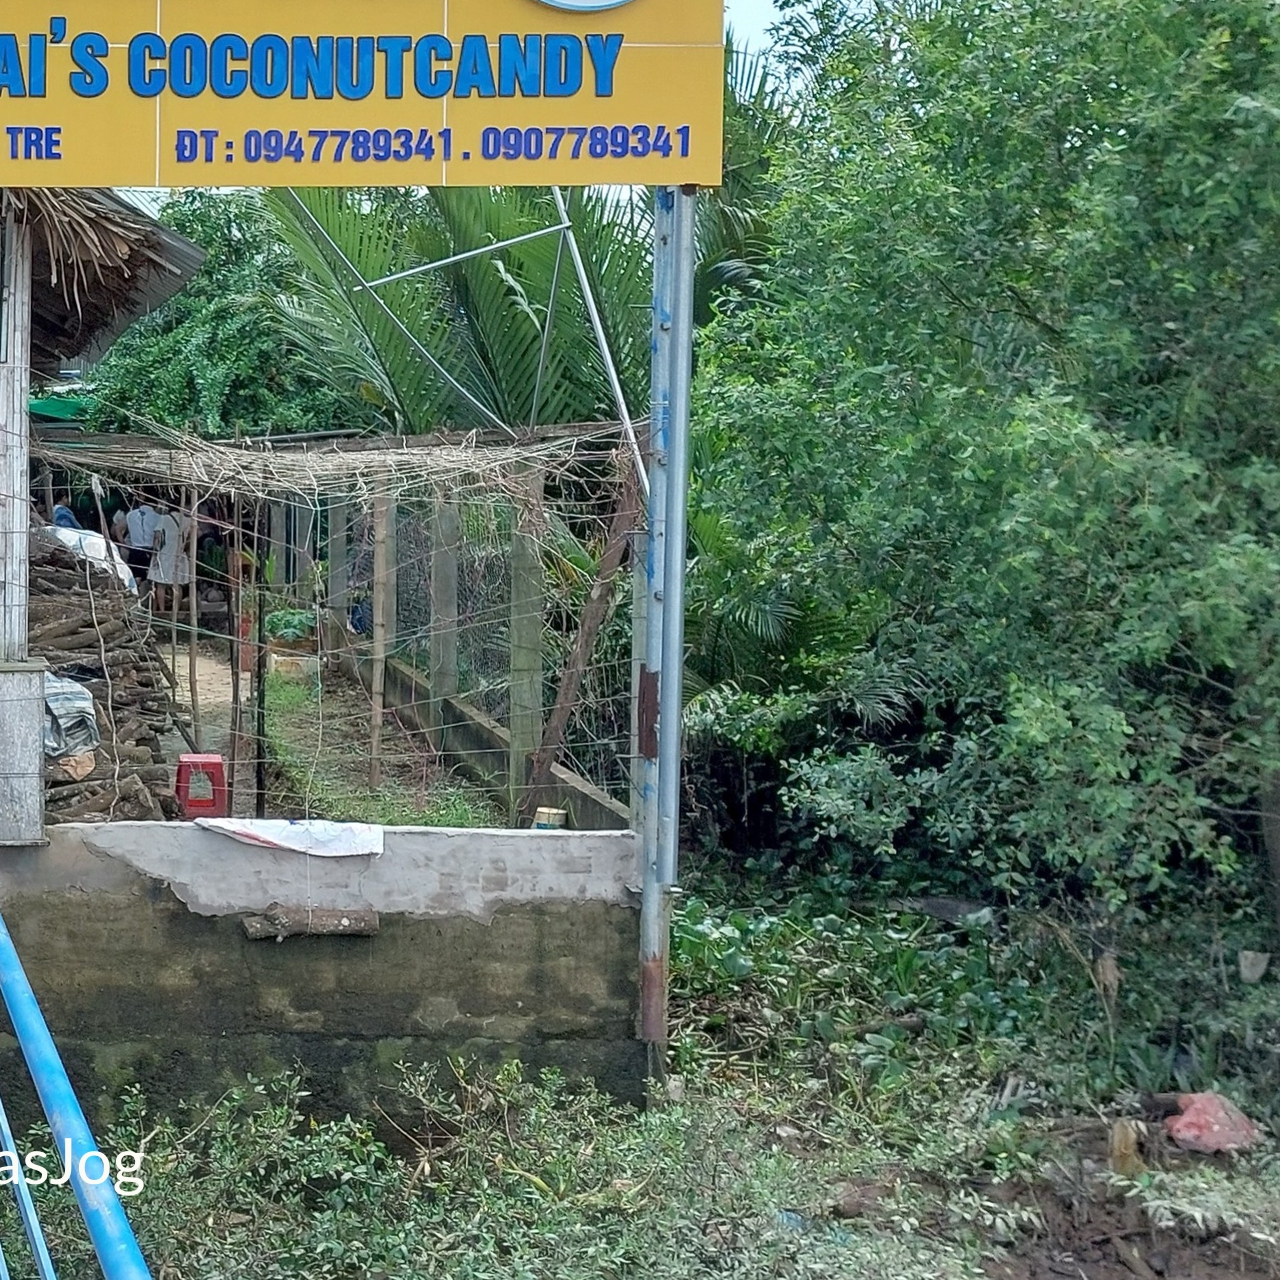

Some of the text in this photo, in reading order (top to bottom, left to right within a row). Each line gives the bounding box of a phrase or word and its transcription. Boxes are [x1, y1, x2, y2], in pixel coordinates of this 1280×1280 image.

[128, 33, 624, 100] COCONUTCANDY
[5, 126, 62, 160] TRE
[244, 128, 452, 163] 0947789341
[481, 125, 692, 160] 0907789341
